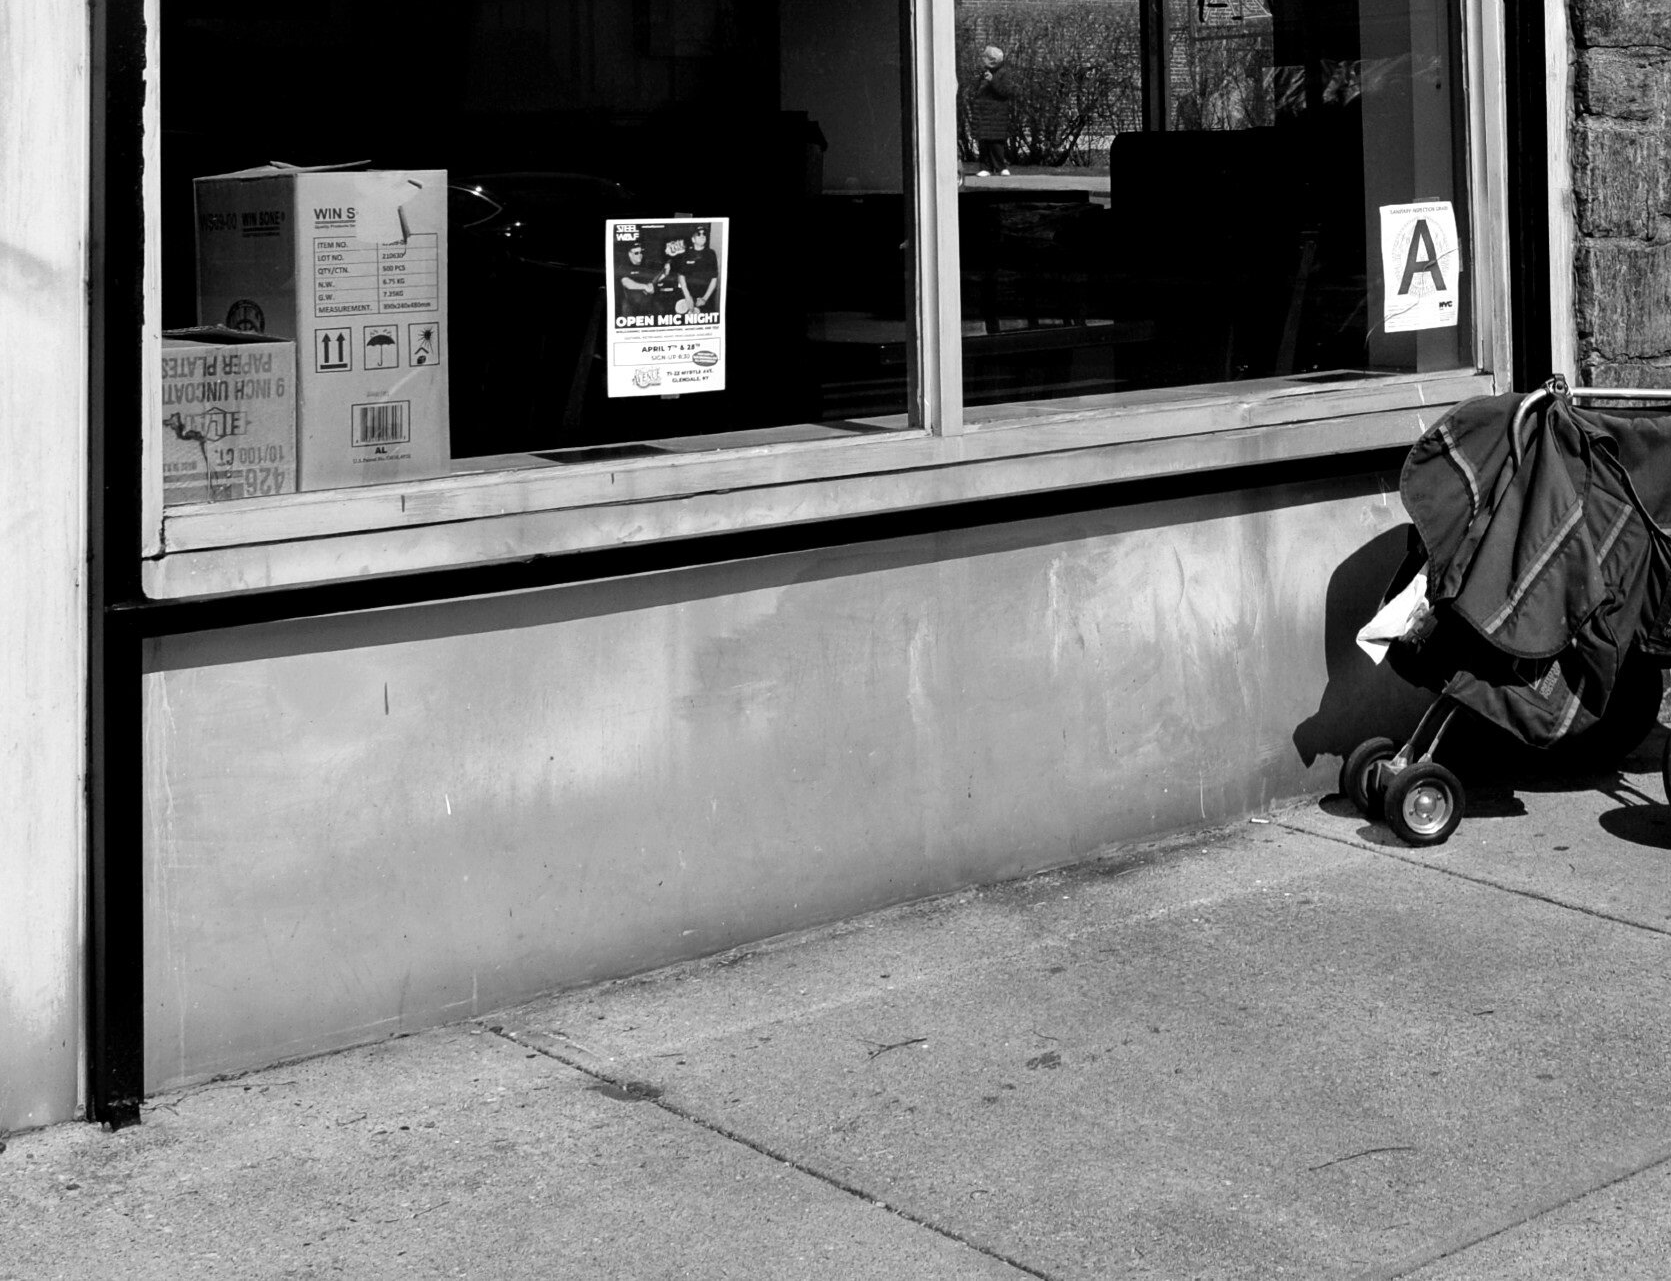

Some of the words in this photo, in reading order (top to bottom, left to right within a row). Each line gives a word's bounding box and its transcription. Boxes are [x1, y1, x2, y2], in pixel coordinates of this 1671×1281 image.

[314, 208, 342, 220] WIN
[1397, 219, 1447, 295] A
[317, 267, 349, 275] QTY/CTN.
[1438, 300, 1453, 308] NYC
[615, 315, 655, 328] OPEN
[657, 313, 682, 326] MIC
[684, 312, 720, 325] NIGHT
[162, 355, 217, 379] PLATES
[222, 353, 272, 375] PAPER
[162, 380, 229, 405] UNCOAT
[235, 379, 272, 400] INCH
[276, 377, 285, 398] 9
[375, 446, 388, 454] AL
[245, 468, 285, 495] 426
